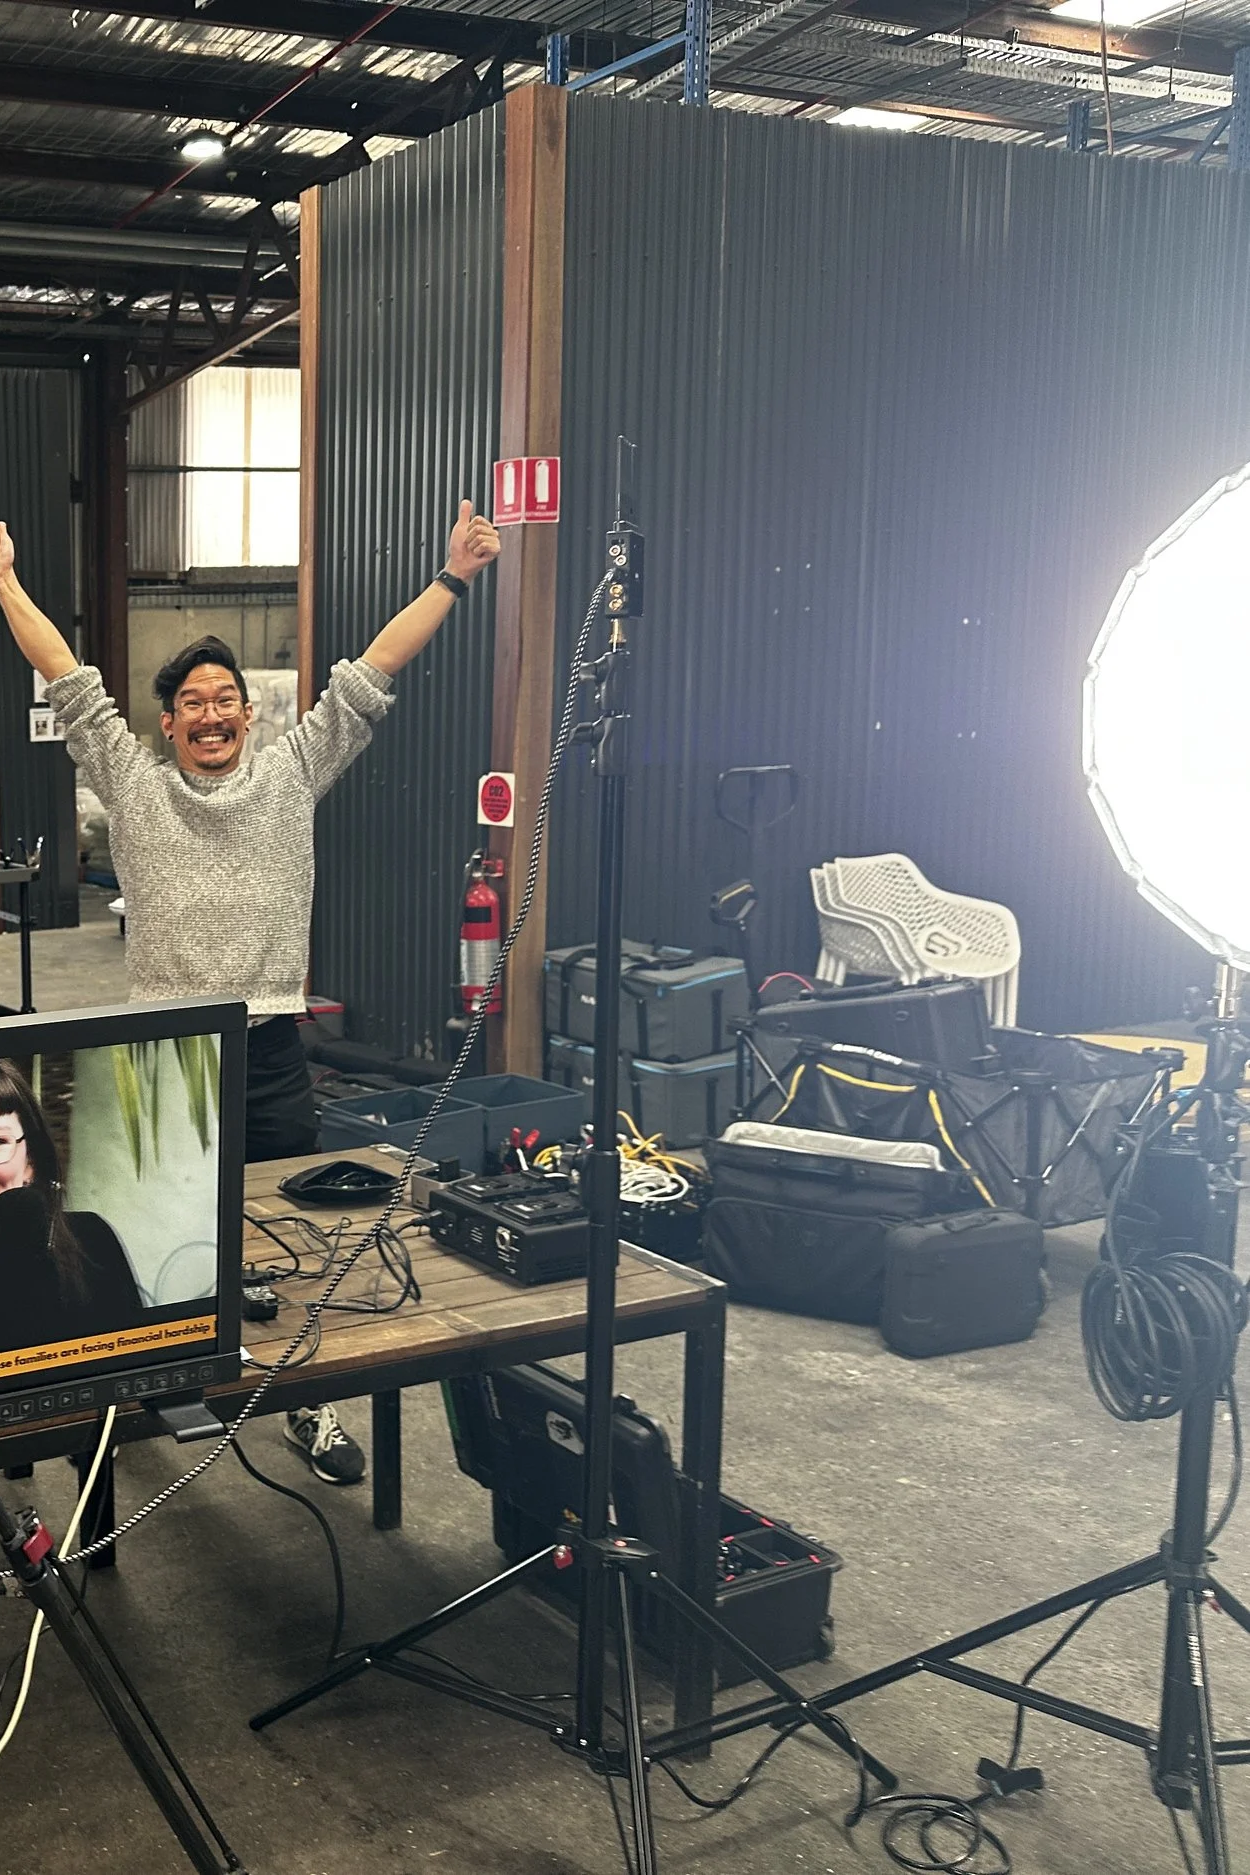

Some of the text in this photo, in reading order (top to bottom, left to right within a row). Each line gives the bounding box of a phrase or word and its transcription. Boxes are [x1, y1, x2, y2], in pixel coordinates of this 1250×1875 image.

[14, 1350, 59, 1367] families
[60, 1346, 80, 1358] are
[81, 1340, 115, 1355] facing
[164, 1322, 211, 1340] hardship
